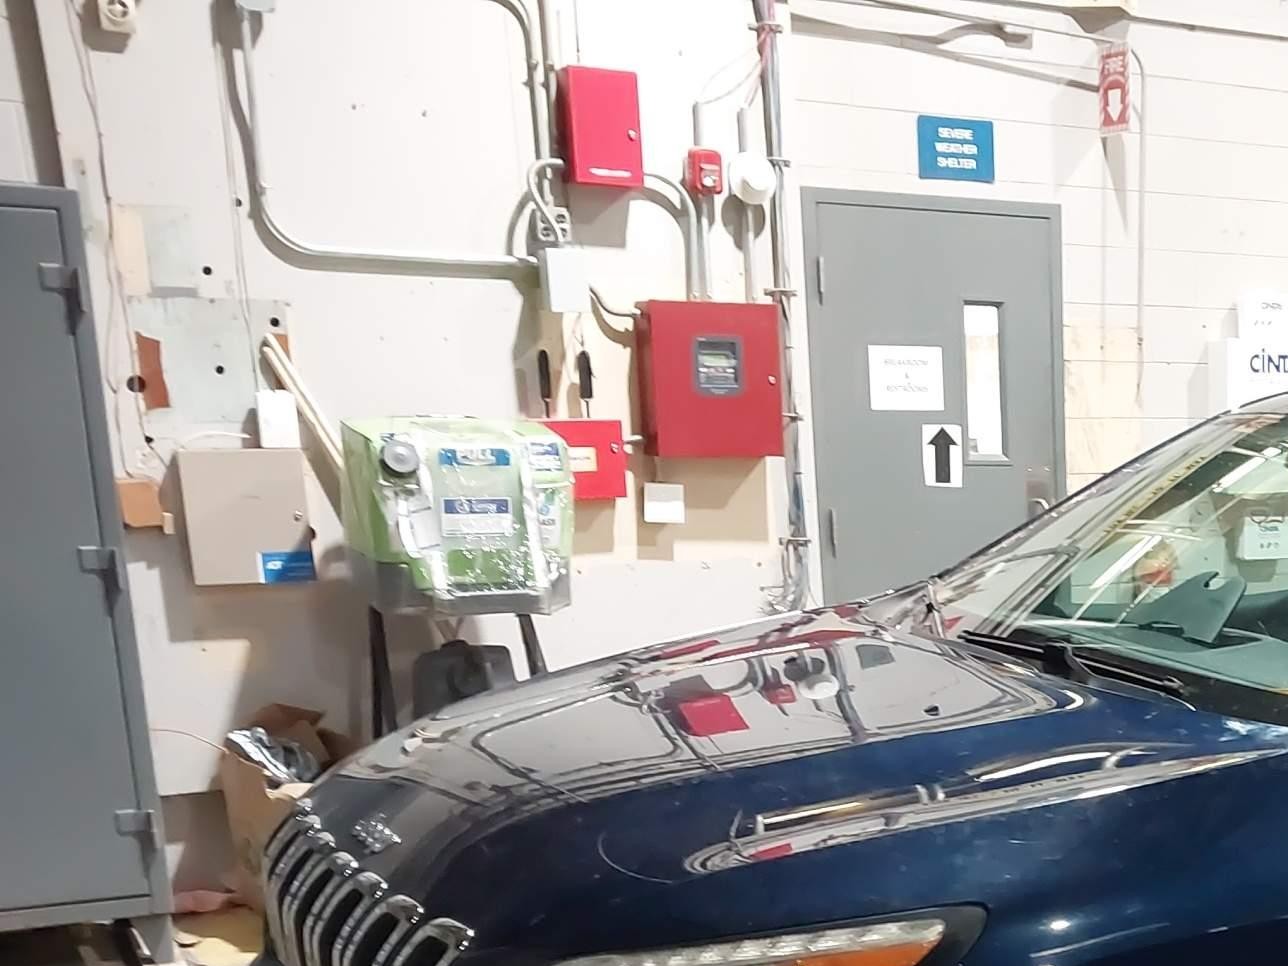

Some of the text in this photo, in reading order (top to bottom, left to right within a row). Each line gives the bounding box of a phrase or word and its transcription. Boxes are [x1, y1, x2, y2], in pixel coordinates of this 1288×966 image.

[937, 126, 975, 141] SEVERE
[934, 141, 979, 155] WEATHER
[936, 156, 978, 170] SHELTER
